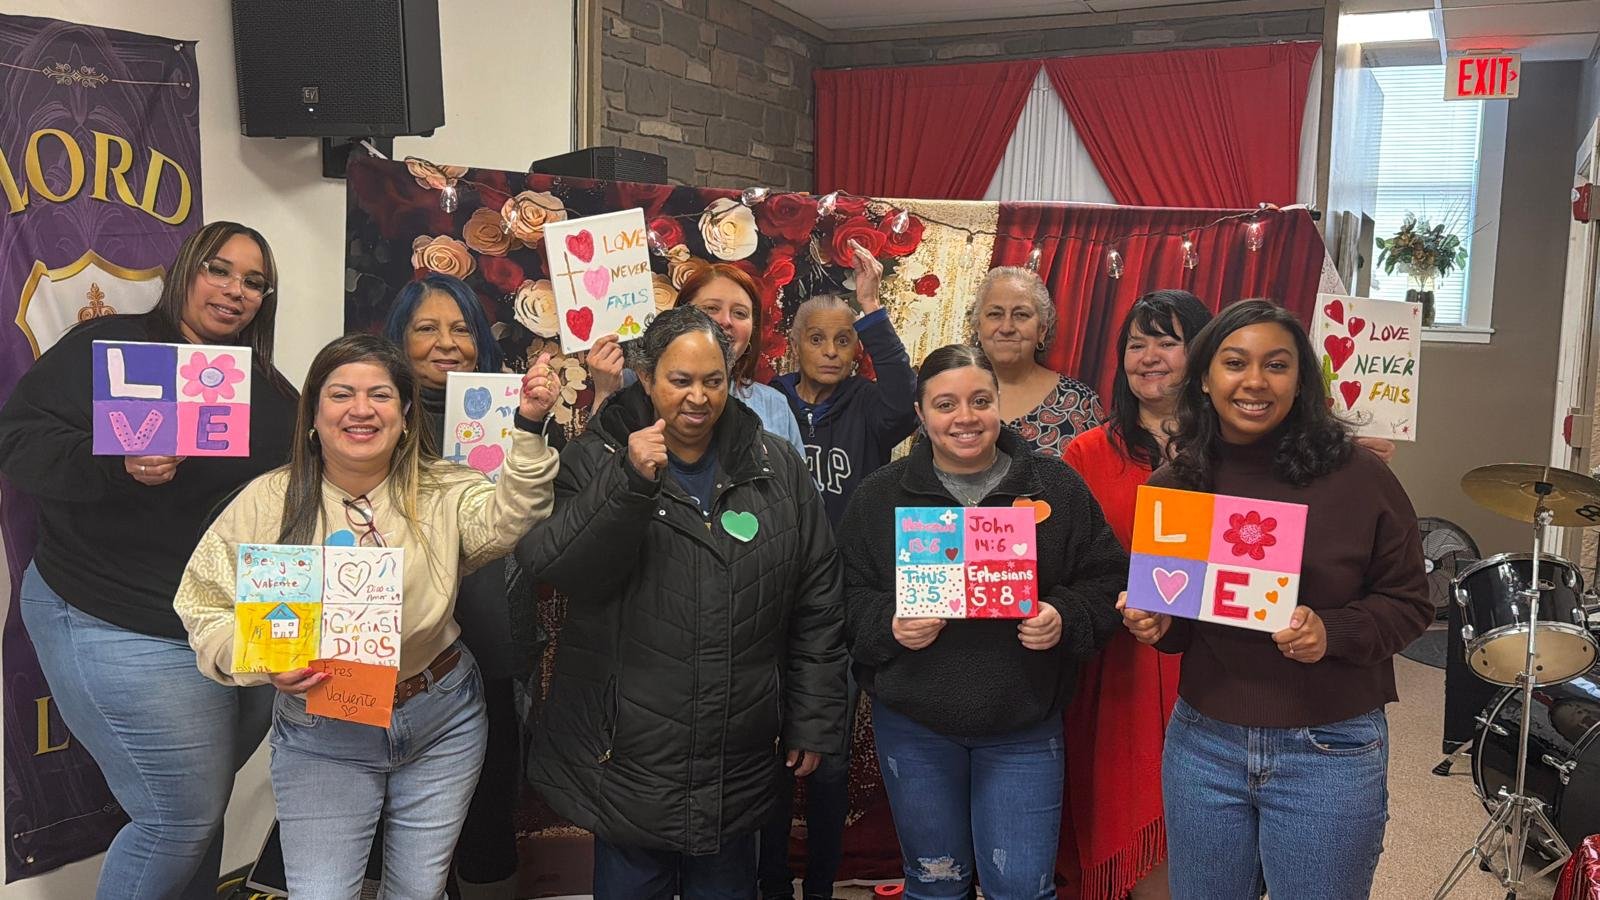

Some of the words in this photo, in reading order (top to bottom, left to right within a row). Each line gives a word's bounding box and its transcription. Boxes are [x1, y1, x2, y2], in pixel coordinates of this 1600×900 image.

[1457, 57, 1513, 96] EXIT
[0, 128, 192, 225] LORD
[603, 229, 646, 254] LOVE
[611, 261, 649, 282] NEVER
[606, 289, 648, 311] FAILS
[1369, 322, 1410, 341] LOVE
[1354, 354, 1415, 376] NEVER
[969, 515, 1014, 534] John
[975, 538, 1006, 552] 14:6
[967, 565, 1034, 583] Ephesians
[971, 585, 1014, 607] 5:8
